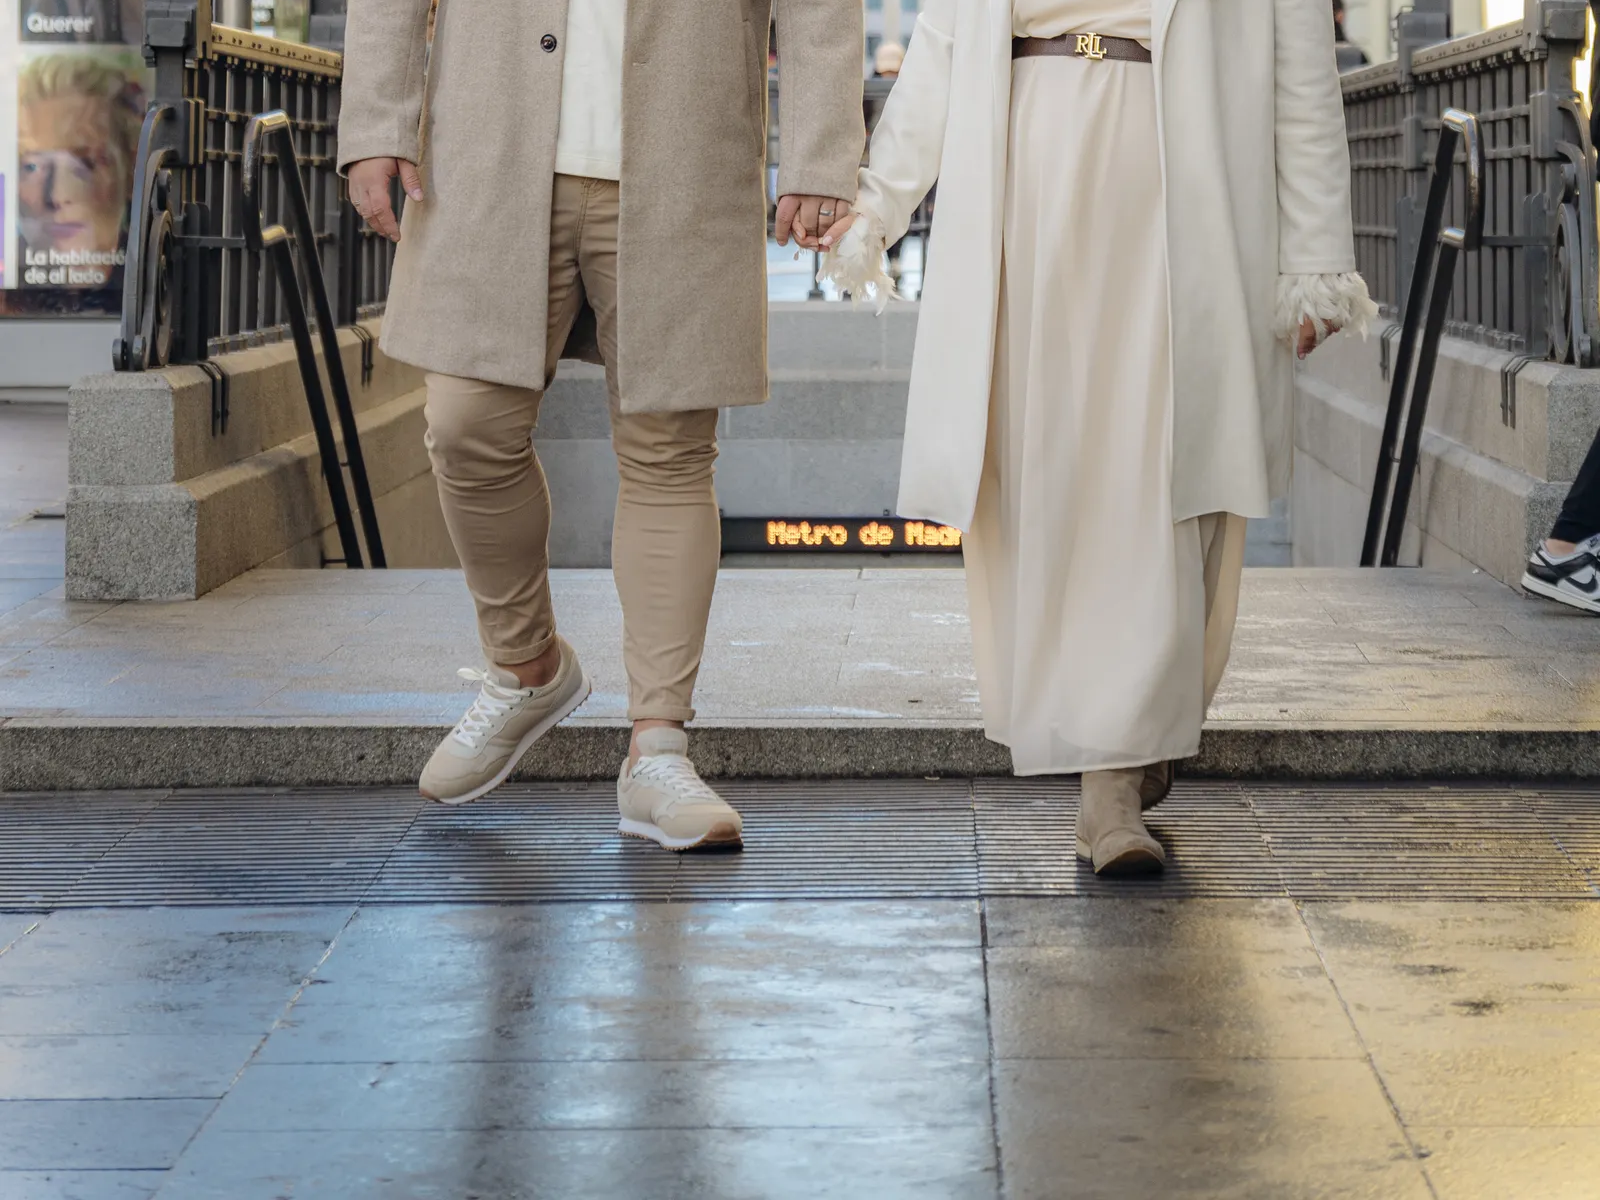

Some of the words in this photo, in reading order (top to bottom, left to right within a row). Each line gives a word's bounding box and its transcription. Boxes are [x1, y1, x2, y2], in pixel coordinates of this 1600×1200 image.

[26, 11, 95, 34] Querer
[25, 246, 47, 266] La
[49, 246, 125, 266] habitació
[24, 266, 48, 285] de
[48, 267, 66, 285] al
[68, 267, 105, 285] lado
[767, 520, 848, 546] Metro
[858, 520, 894, 546] de
[904, 520, 962, 546] Madr
